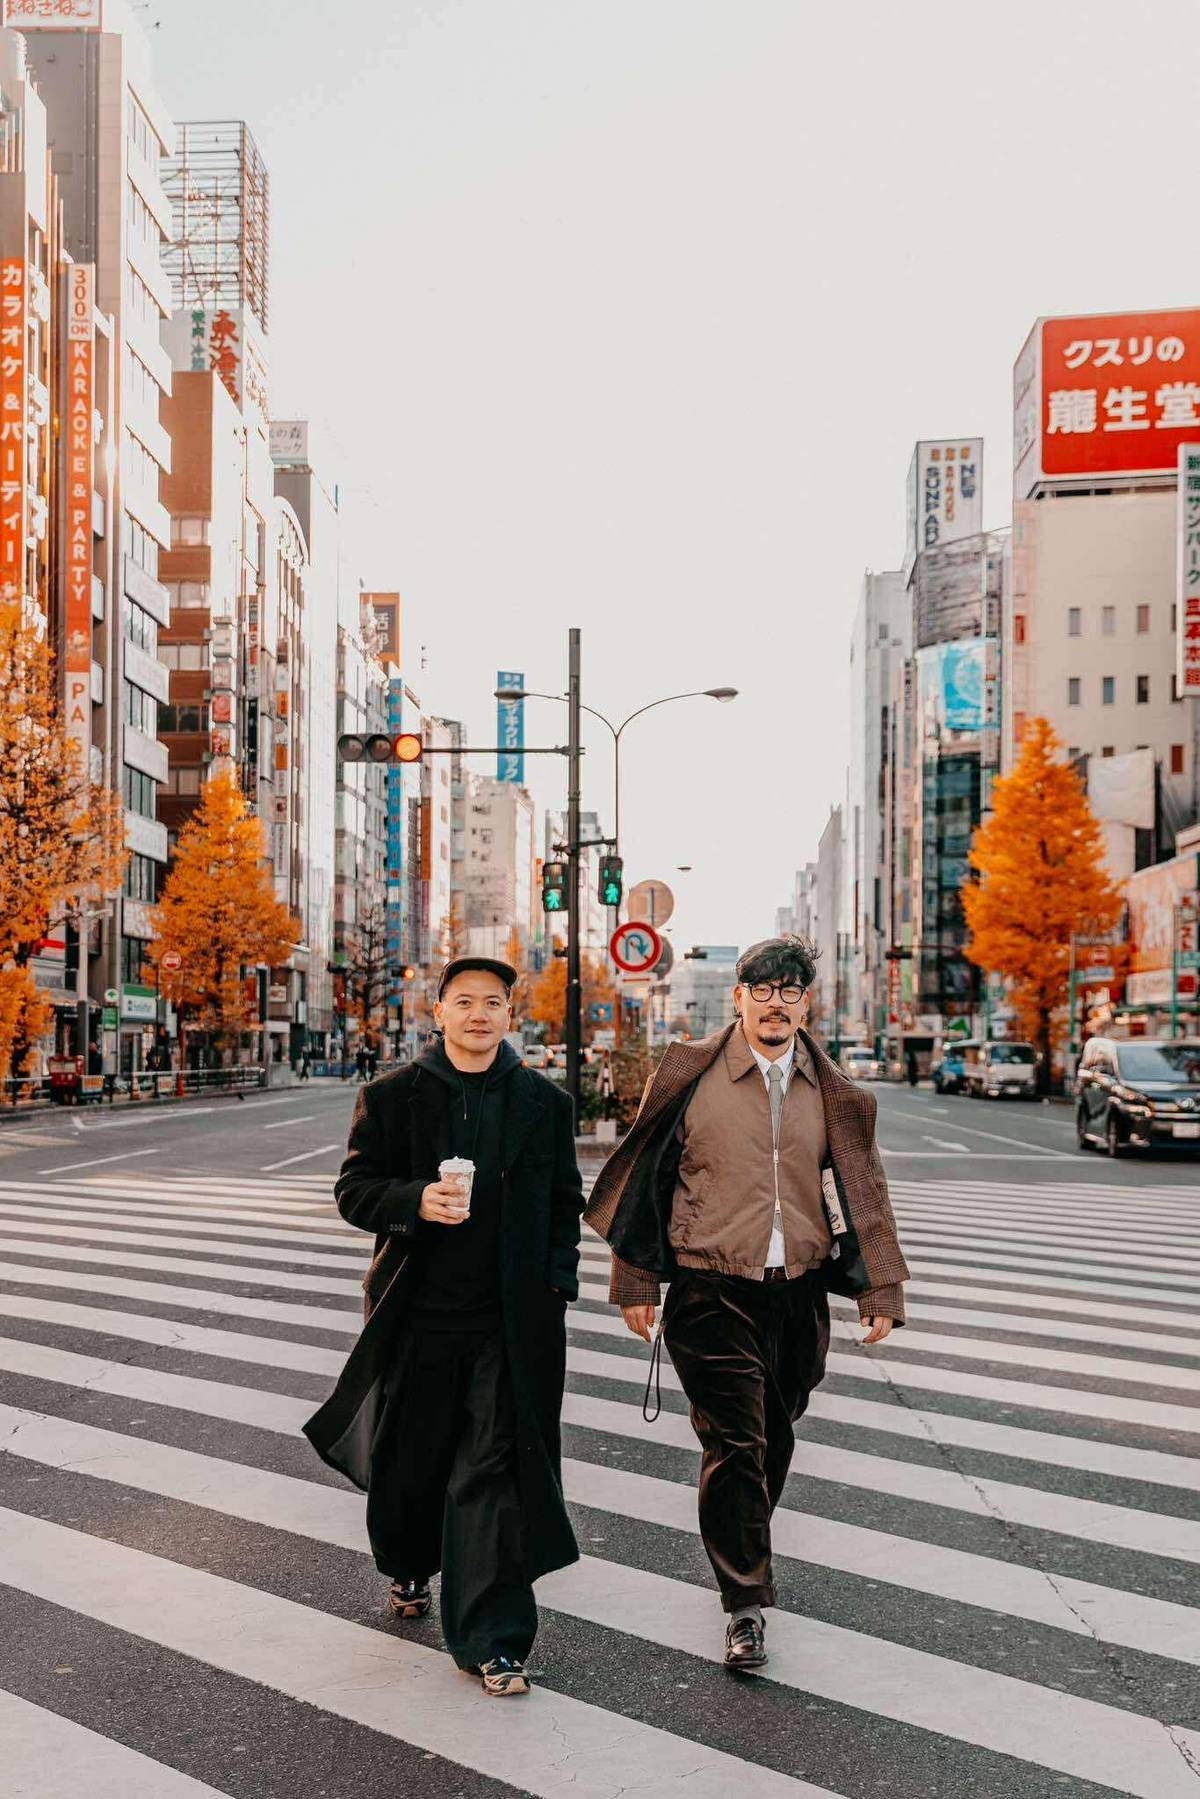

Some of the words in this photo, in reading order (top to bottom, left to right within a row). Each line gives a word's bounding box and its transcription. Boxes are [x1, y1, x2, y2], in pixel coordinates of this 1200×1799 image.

[74, 269, 86, 316] 300
[1063, 335, 1185, 369] クスリの
[73, 343, 87, 473] KARAOKE
[73, 483, 87, 498] &
[72, 509, 87, 600] PARTY
